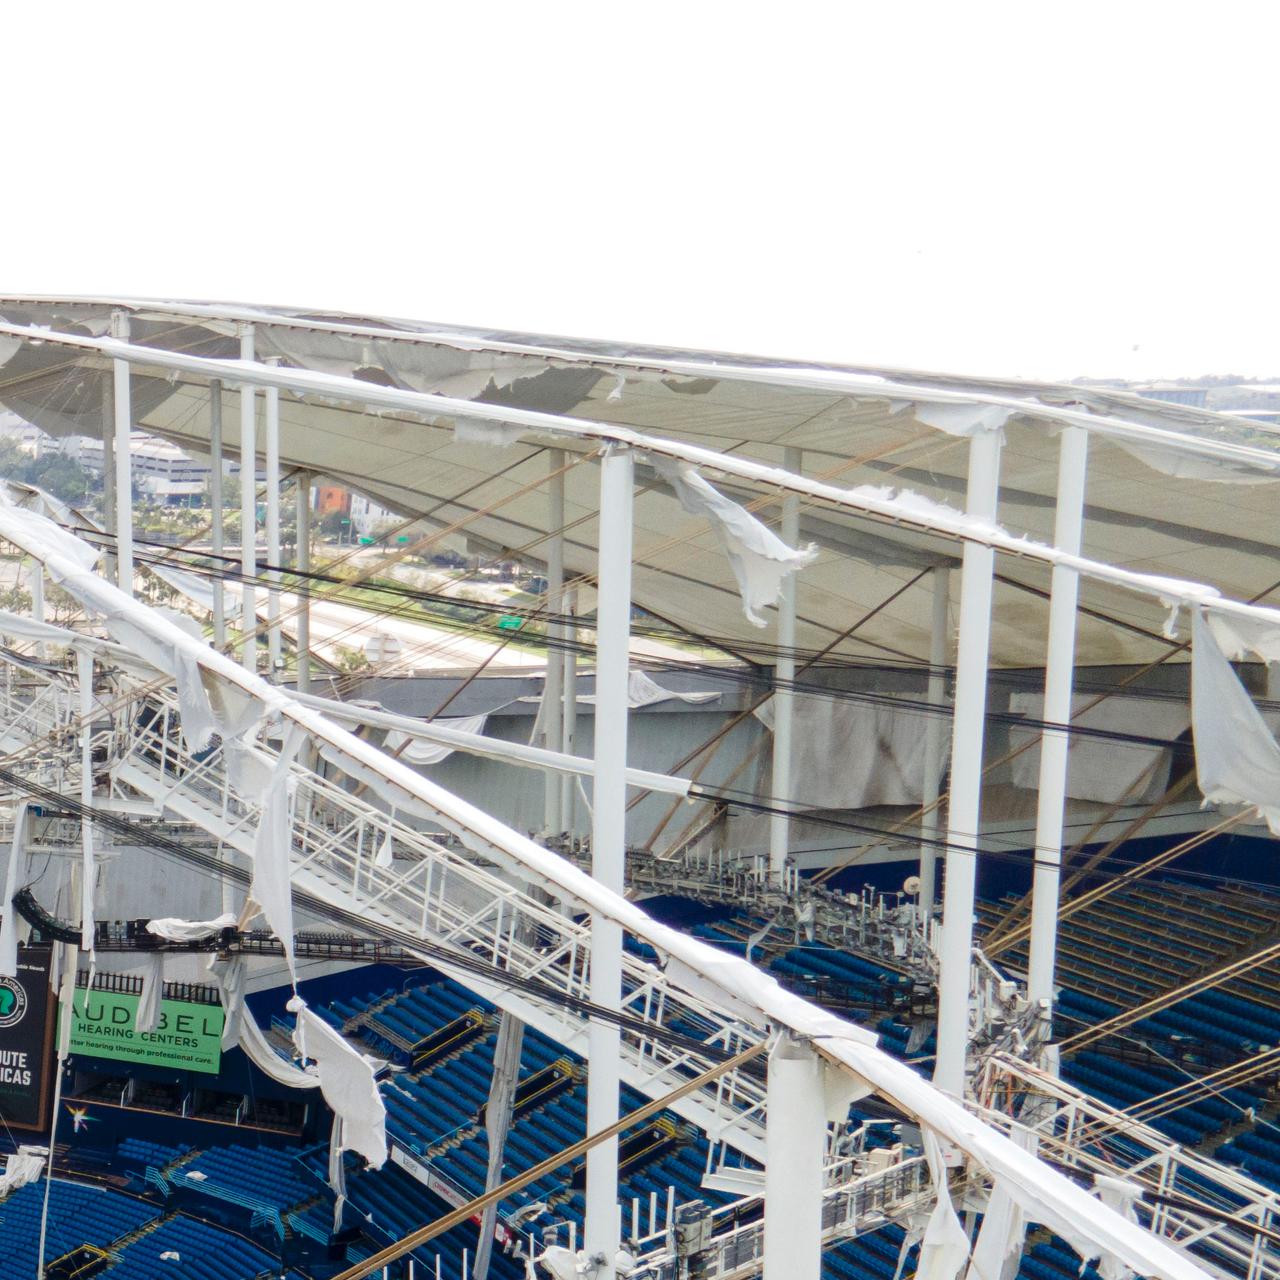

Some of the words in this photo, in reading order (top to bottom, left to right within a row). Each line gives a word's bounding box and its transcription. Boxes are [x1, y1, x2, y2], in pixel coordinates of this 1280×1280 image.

[70, 1003, 220, 1038] UDBEL
[78, 1022, 134, 1039] HEARING
[140, 1031, 199, 1048] CENTERS
[70, 1039, 85, 1048] tter
[86, 1040, 114, 1052] hearing
[115, 1044, 146, 1056] through
[146, 1048, 193, 1063] professional
